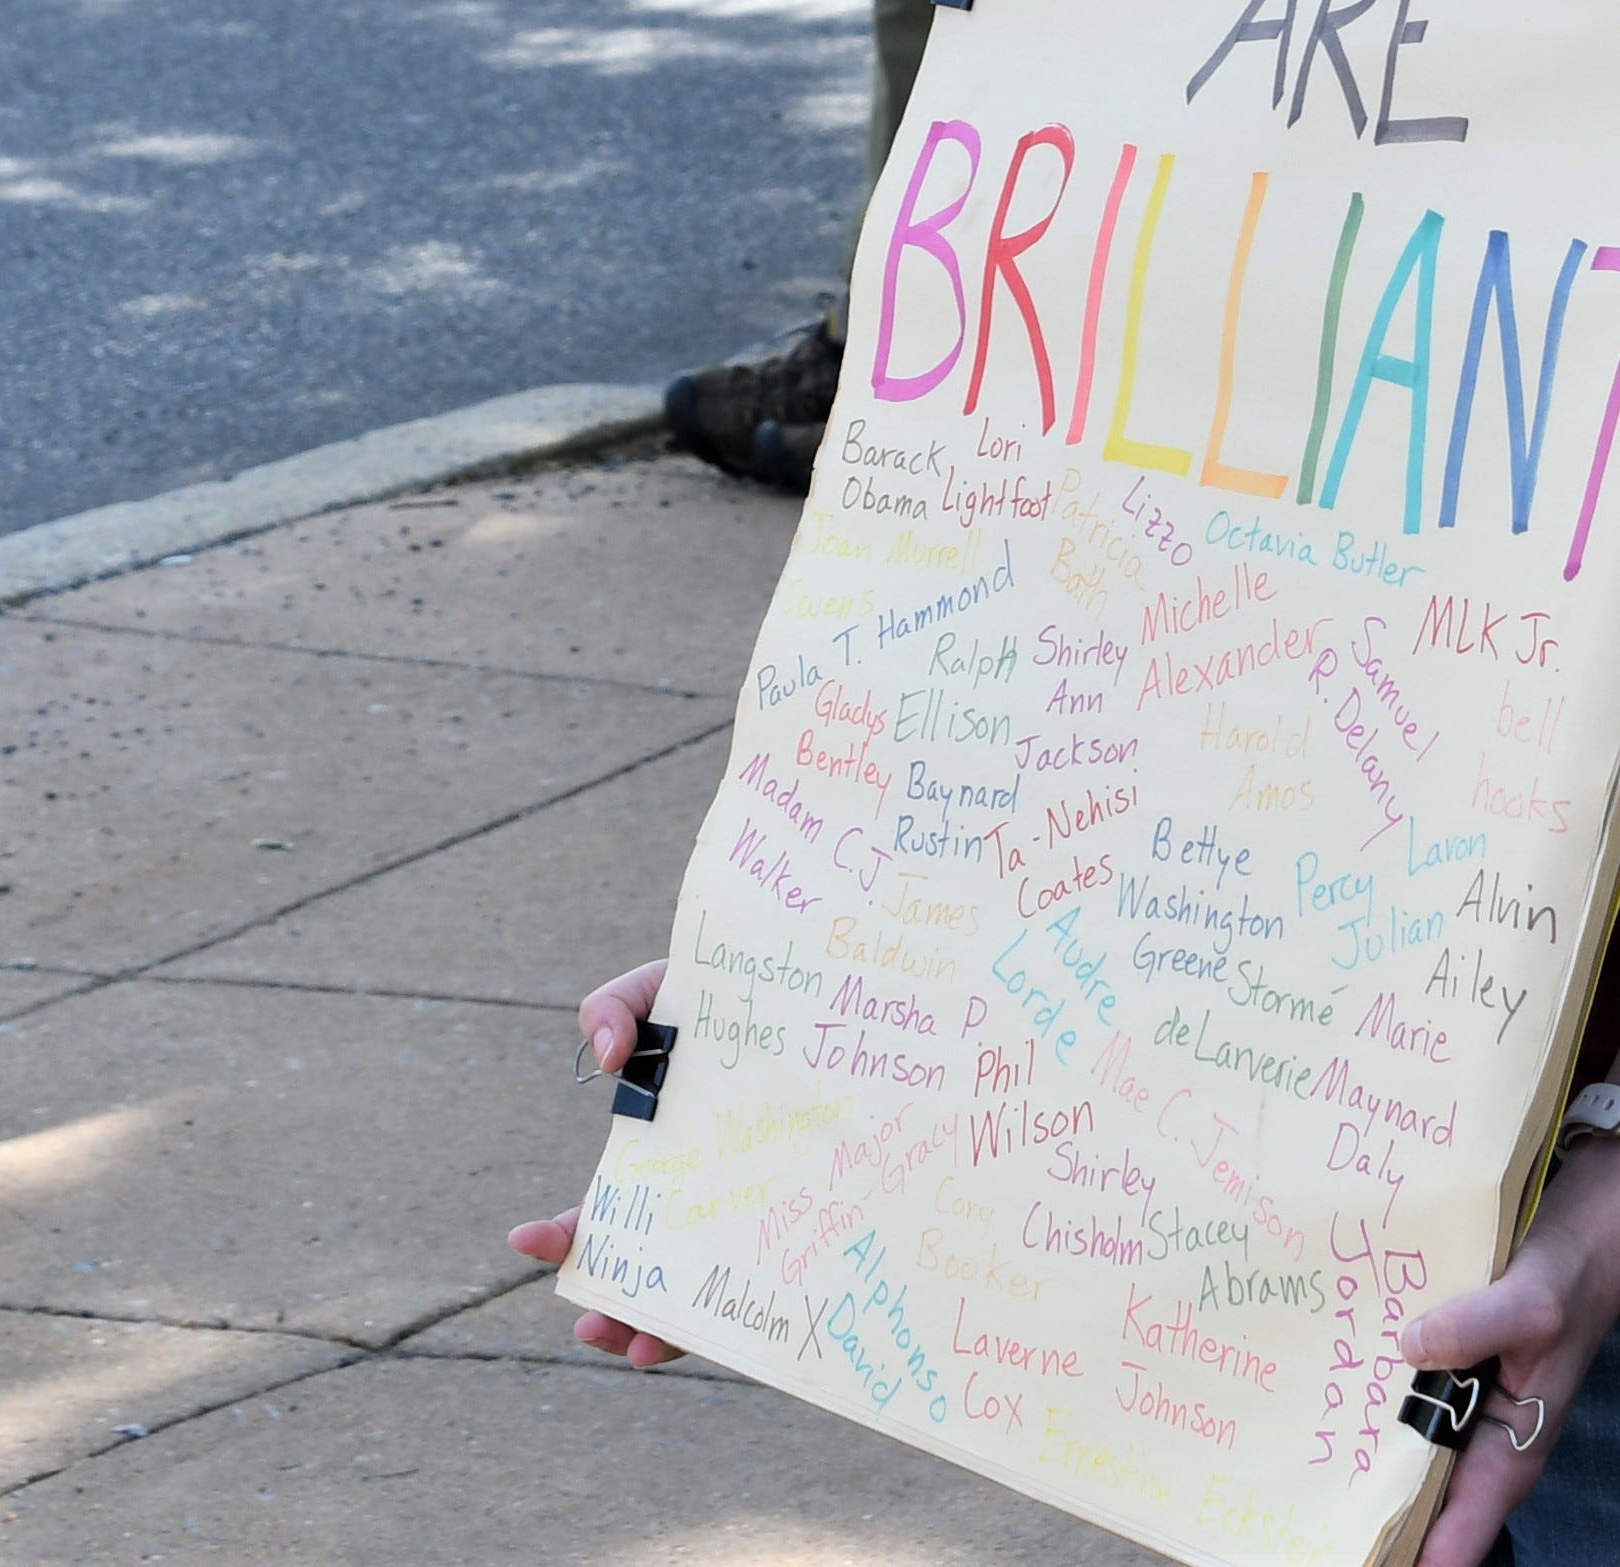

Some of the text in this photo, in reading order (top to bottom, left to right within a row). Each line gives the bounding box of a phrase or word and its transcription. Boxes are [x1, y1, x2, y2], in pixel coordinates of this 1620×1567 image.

[841, 419, 947, 477] Barack
[977, 417, 1026, 463] Lori
[841, 476, 928, 520] Obama
[941, 466, 1052, 528] Lightfoot
[1120, 475, 1193, 566] Lizzo
[1204, 509, 1426, 588] Octavia Butler
[756, 538, 1015, 711] Paula T. Hammond
[1140, 561, 1278, 646] Michelle
[1411, 594, 1560, 673] MLK Jr.
[927, 631, 1019, 690] Ralph
[1032, 624, 1129, 688] Shirley
[1136, 617, 1334, 711] Alexander
[1350, 616, 1440, 762] Samuel
[814, 679, 887, 743] Gladys
[893, 688, 1012, 746] Ellison
[1044, 678, 1104, 715] Ann
[1199, 700, 1312, 761] Harold
[1495, 679, 1566, 754] bell
[795, 729, 894, 821] Bentley
[1014, 733, 1138, 772] Jackson
[1227, 763, 1315, 813] Amos
[1333, 687, 1404, 853] Delany
[738, 752, 824, 844] Madam
[1470, 751, 1573, 834] hooks
[728, 817, 823, 915] Walker
[893, 814, 983, 863] Rustin
[1151, 816, 1252, 891] Bettye
[880, 871, 980, 937] James
[1017, 853, 1114, 920] Coates
[1116, 871, 1284, 955] Washington
[1295, 850, 1374, 929] Percy
[1455, 868, 1557, 945] Alvin
[693, 909, 824, 1000] Langston
[824, 916, 957, 983] Baldwin
[1044, 905, 1118, 1027] Audre
[1132, 930, 1228, 983] Greene
[1330, 904, 1444, 971] Julian
[692, 989, 787, 1071] Hughes
[829, 973, 937, 1036] Marsha
[991, 928, 1078, 1067] Lorde
[1354, 991, 1453, 1064] Marie
[1423, 947, 1528, 1046] Ailey
[802, 1022, 946, 1092] Johnson
[973, 1038, 1036, 1098] Phil
[970, 1098, 1095, 1168] Wilson
[1310, 1056, 1459, 1148] Maynard
[756, 1101, 915, 1266] Miss Major
[1046, 1140, 1157, 1228] Shirley
[1090, 1029, 1150, 1114] Mae
[1189, 1112, 1307, 1263] Jemison
[1326, 1121, 1406, 1230] Daly
[589, 1176, 663, 1235] Willi
[1021, 1200, 1144, 1266] Chisholm
[1147, 1204, 1251, 1261] Stacey
[577, 1234, 668, 1298] Ninja
[1198, 1260, 1327, 1314] Abrams
[691, 1263, 830, 1361] Malcolm X
[827, 1290, 904, 1409] David
[843, 1228, 948, 1424] Alphonso
[951, 1296, 1085, 1378] Laverne
[1120, 1282, 1278, 1394] Katherine
[1307, 1210, 1381, 1465] Jordan
[963, 1371, 1024, 1436] Cox
[1114, 1360, 1238, 1450] Johnson
[1348, 1249, 1428, 1489] Barbara
